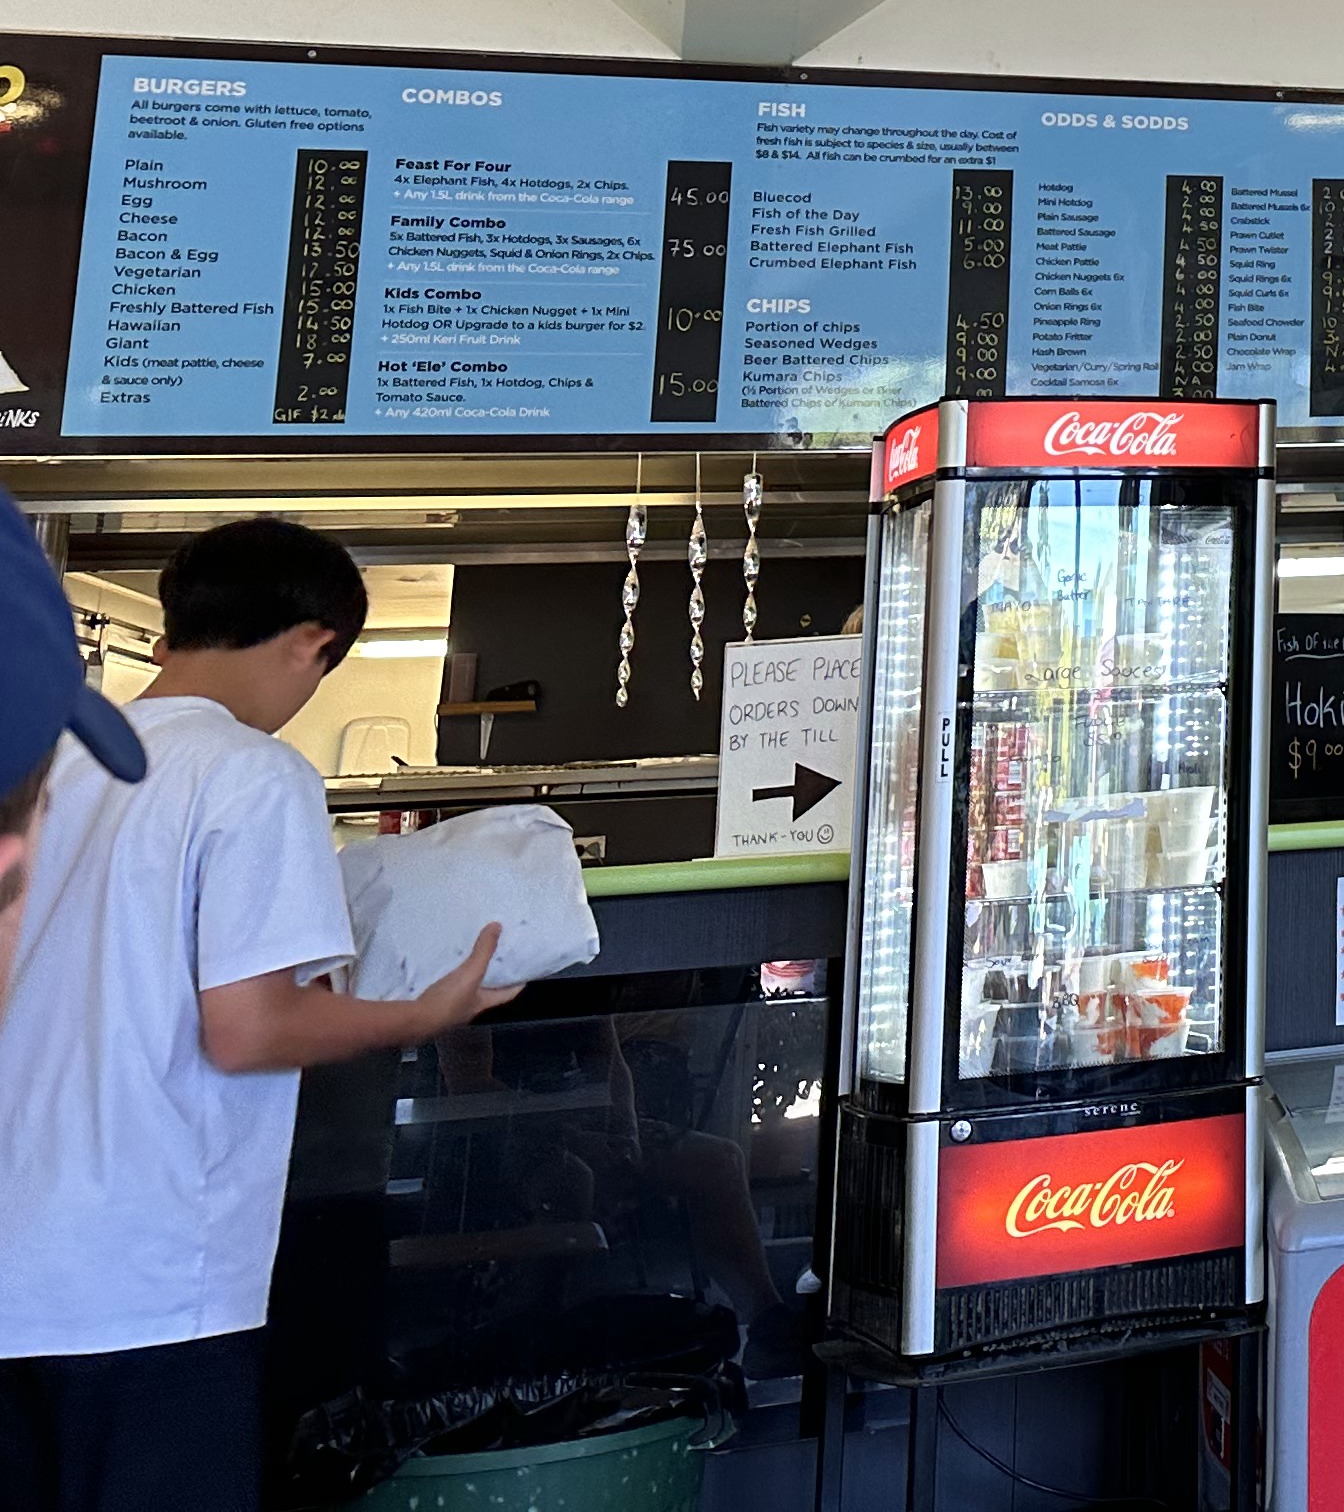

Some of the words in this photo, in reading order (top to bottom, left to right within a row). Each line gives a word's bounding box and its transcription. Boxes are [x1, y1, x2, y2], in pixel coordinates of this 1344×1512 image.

[133, 77, 247, 97] BURGERS
[402, 88, 502, 106] COMBOS
[758, 102, 806, 118] FISH
[1041, 112, 1097, 127] ODDS
[1103, 115, 1115, 128] &
[1122, 115, 1188, 130] SODDS
[125, 159, 163, 172] Plain
[308, 159, 360, 173] 10.00
[396, 159, 439, 171] Feast
[444, 160, 471, 171] For
[475, 161, 512, 173] Four
[123, 177, 207, 190] Mushroom
[121, 195, 153, 208] Egg
[753, 192, 812, 203] Bluecod
[119, 212, 178, 225] Cheese
[752, 208, 781, 219] Fish
[786, 209, 801, 219] of
[805, 210, 827, 220] the
[833, 211, 860, 223] Day
[391, 216, 444, 229] Family
[449, 217, 506, 229] Combo
[117, 230, 167, 242] Bacon
[751, 225, 790, 236] Fresh
[795, 226, 824, 236] Fish
[829, 226, 876, 237] Grilled
[115, 248, 165, 260] Bacon
[171, 249, 181, 260] &
[187, 250, 219, 262] Egg
[750, 242, 812, 253] Battered
[818, 242, 880, 255] Elephant
[886, 243, 914, 253] Fish
[750, 258, 815, 269] Crumbed
[821, 259, 883, 270] Elephant
[889, 260, 917, 270] Fish
[114, 266, 201, 279] Vegetarian
[111, 284, 176, 295] Chicken
[301, 281, 355, 297] 15.00
[385, 288, 419, 300] Kids
[424, 288, 482, 300] Combo
[110, 302, 166, 315] Freshly
[171, 302, 238, 314] Battered
[243, 303, 274, 315] Fish
[746, 299, 811, 313] CHIPS
[108, 320, 181, 332] Hawaiian
[745, 322, 798, 333] Portion
[803, 322, 818, 332] of
[823, 322, 860, 334] chips
[106, 338, 149, 349] Giant
[745, 339, 816, 349] Seasoned
[820, 339, 877, 350] Wedges
[104, 356, 138, 367] Kids
[378, 361, 407, 373] Hot
[451, 361, 508, 373] Combo
[744, 355, 777, 365] Beer
[782, 355, 844, 365] Battered
[850, 356, 889, 366] Chips
[743, 372, 797, 382] Kumara
[803, 372, 842, 382] Chips
[658, 373, 719, 396] 15.00
[100, 392, 150, 403] Extras
[1043, 412, 1185, 457] Coca-Cola
[1277, 627, 1299, 653] Fish
[731, 658, 801, 688] PLEASE
[813, 657, 862, 680] PLACE
[729, 700, 799, 725] ORDERS
[813, 696, 860, 714] DOWN
[730, 735, 749, 751] BY
[760, 731, 789, 749] THE
[801, 728, 839, 746] TILL
[941, 717, 950, 778] PULL
[1084, 1103, 1138, 1117] serene
[1005, 1158, 1185, 1239] Coca-Cola
